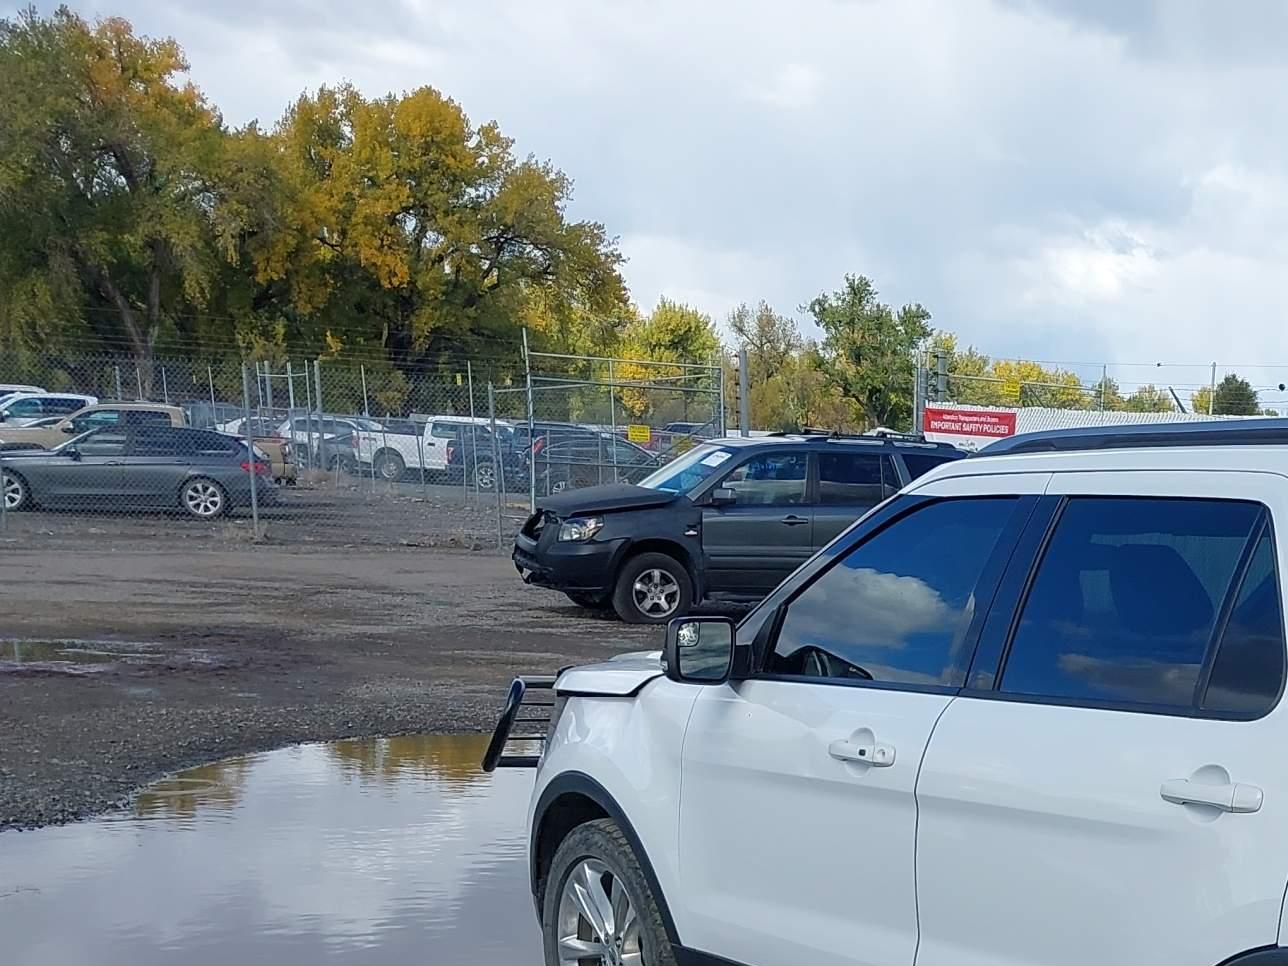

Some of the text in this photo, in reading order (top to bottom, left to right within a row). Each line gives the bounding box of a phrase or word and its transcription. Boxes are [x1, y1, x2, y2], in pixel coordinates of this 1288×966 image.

[931, 421, 1009, 433] IMPORTANT SAFETY POLICIES
